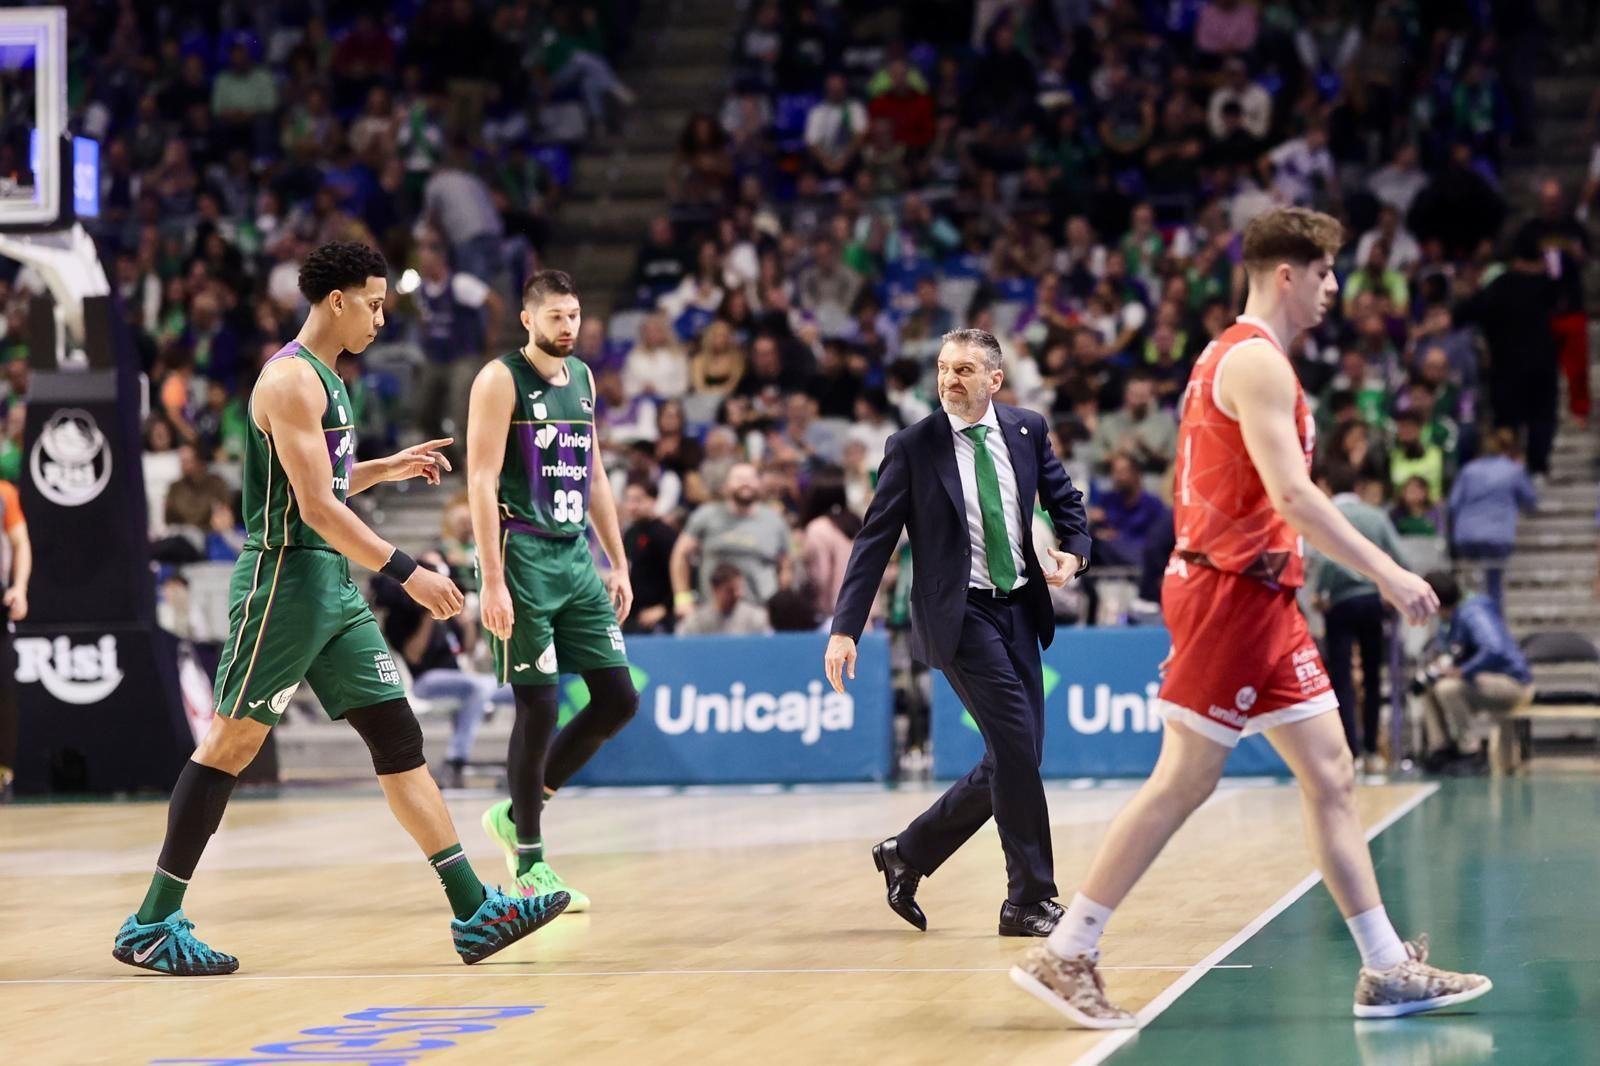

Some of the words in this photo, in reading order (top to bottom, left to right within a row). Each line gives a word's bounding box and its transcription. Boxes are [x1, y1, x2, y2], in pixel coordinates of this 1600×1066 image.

[554, 489, 584, 523] 33
[13, 634, 124, 704] Risi
[654, 680, 855, 745] Unicaja
